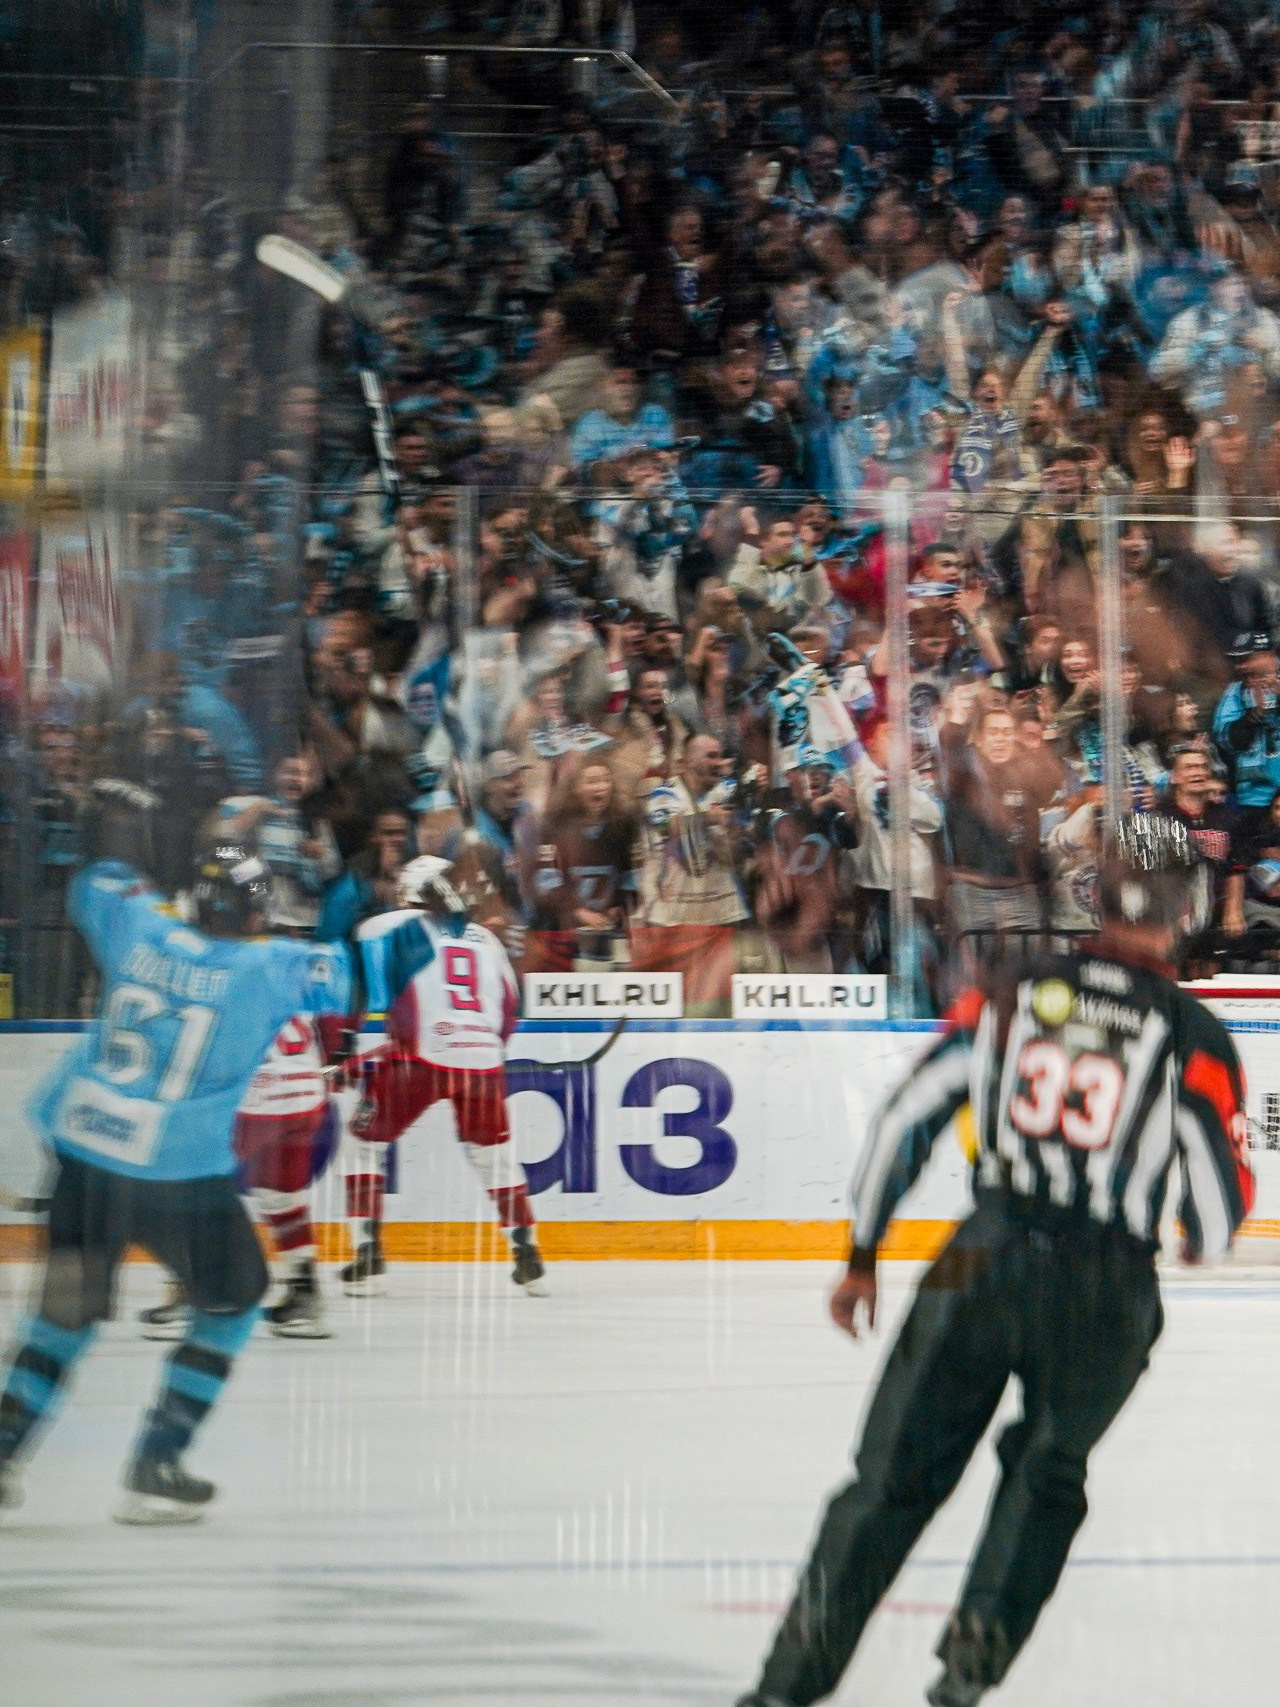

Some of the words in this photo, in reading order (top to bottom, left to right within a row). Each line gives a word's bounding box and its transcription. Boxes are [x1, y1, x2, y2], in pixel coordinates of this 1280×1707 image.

[444, 946, 482, 1012] 9
[537, 984, 672, 1007] KHL.RU
[743, 985, 876, 1008] KHL.RU
[102, 982, 217, 1102] 61
[1009, 1041, 1126, 1150] 33
